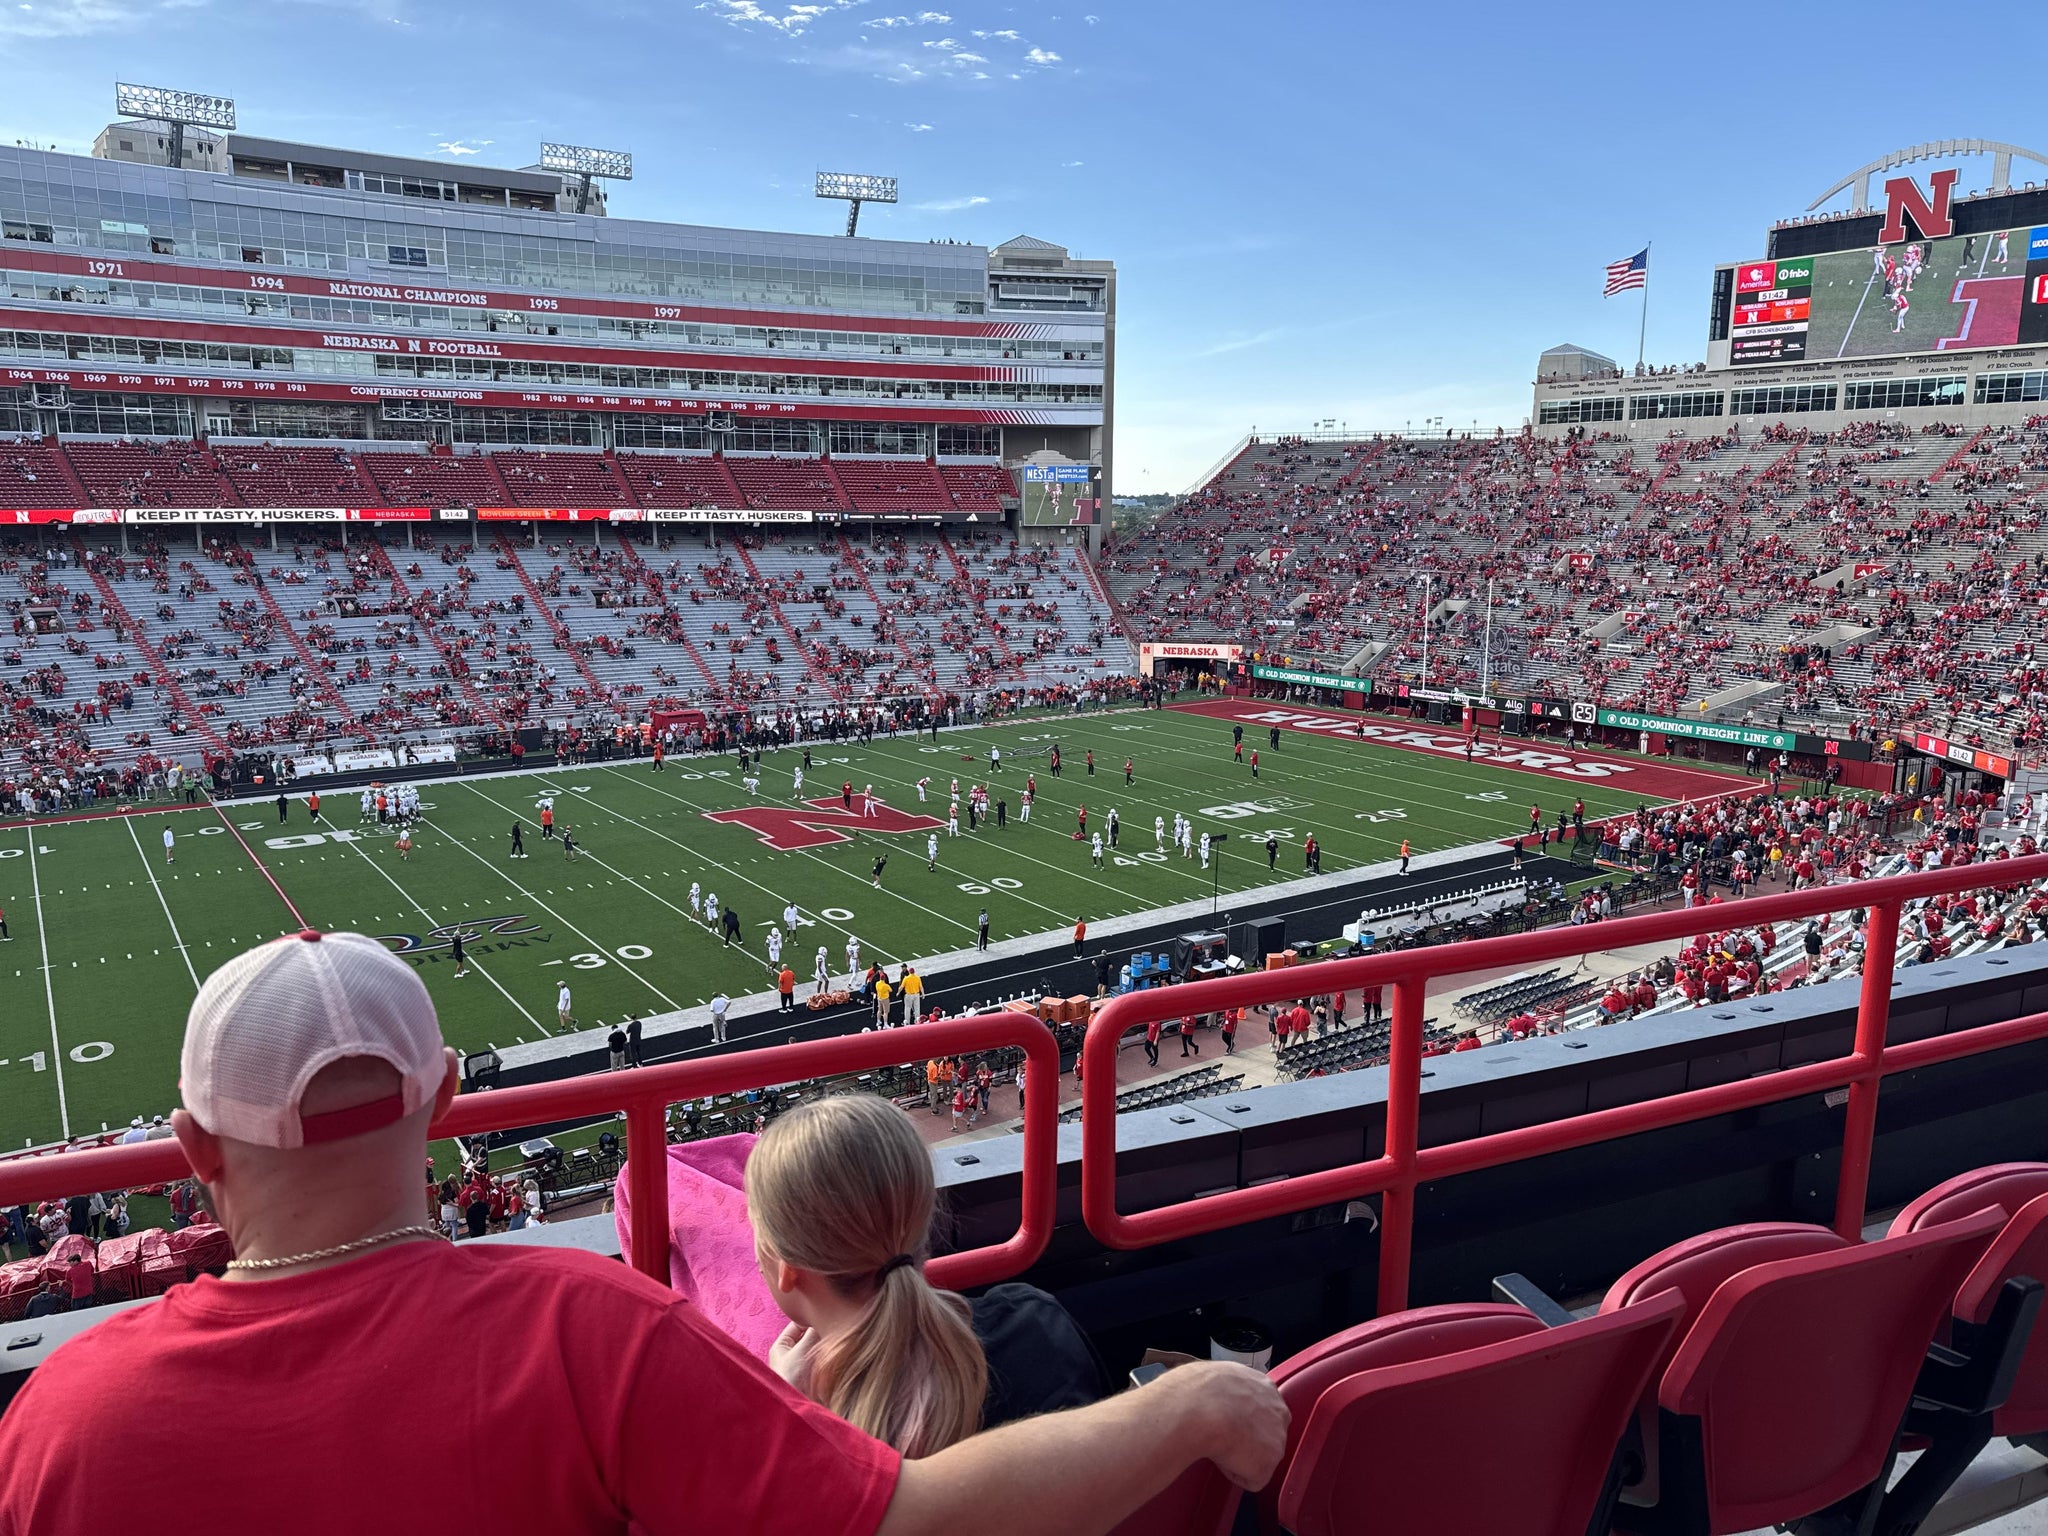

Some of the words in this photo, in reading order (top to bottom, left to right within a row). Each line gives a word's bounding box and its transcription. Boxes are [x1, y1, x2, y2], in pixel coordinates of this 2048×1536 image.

[1878, 168, 1961, 245] N
[1775, 206, 1878, 230] MEMORIAL
[88, 261, 124, 276] 1971
[1790, 269, 1809, 278] fnbo
[250, 276, 284, 290] 1994
[1740, 280, 1771, 290] Ameritas
[329, 283, 401, 299] NATIONAL
[404, 289, 487, 305] CHAMPIONS
[1762, 291, 1785, 300] 51:42
[529, 298, 558, 310] 1995
[654, 307, 681, 319] 1997
[1747, 311, 1758, 323] N
[1757, 325, 1795, 334] SCOREBOARD
[323, 335, 399, 350] NEBRASKA
[408, 340, 421, 352] N
[428, 341, 501, 356] FOOTBALL
[8, 370, 33, 380] 1964
[45, 371, 70, 381] 1966
[83, 373, 107, 384] 1969
[118, 375, 142, 385] 1970
[154, 377, 176, 387] 1971
[187, 379, 210, 389] 1972
[221, 380, 244, 390] 1975
[254, 382, 276, 391] 1978
[286, 383, 307, 393] 1981
[350, 386, 419, 398] CONFERENCE
[420, 389, 483, 400] CHAMPIONS
[522, 394, 540, 402] 1982
[549, 395, 567, 403] 1983
[576, 396, 594, 404] 1984
[602, 397, 620, 405] 1988
[629, 398, 645, 406] 1991
[730, 402, 747, 410] 1995
[779, 404, 796, 412] 1999
[1027, 468, 1049, 479] NEST
[16, 511, 30, 523] N
[136, 511, 175, 521] KEEP
[185, 511, 199, 520] IT
[202, 510, 258, 522] TASTY,
[261, 510, 339, 520] HUSKERS.
[349, 510, 361, 520] N
[568, 510, 579, 520] N
[655, 511, 687, 519] KEEP
[689, 511, 702, 519] IT
[704, 512, 746, 521] TASTY,
[747, 512, 807, 520] HUSKERS.
[1143, 646, 1150, 654] N
[1162, 646, 1218, 656] NEBRASKA
[1232, 648, 1239, 656] N
[1238, 664, 1245, 674] N
[1472, 660, 1520, 675] Alstate
[1266, 670, 1279, 678] OLD
[1279, 672, 1310, 683] DOMINION
[1311, 675, 1339, 687] FREIGHT
[1340, 679, 1356, 689] LINE
[1398, 685, 1409, 697] N
[1532, 703, 1542, 715] N
[1576, 706, 1592, 716] 25
[1619, 716, 1639, 726] OLD
[1641, 718, 1692, 734] DOMINION
[1695, 726, 1741, 741] FREIGHT
[1744, 732, 1769, 744] LINE
[1233, 710, 1637, 778] HUSKERS
[1824, 740, 1839, 755] N
[1927, 738, 1936, 752] N
[1951, 749, 1970, 762] 51:42
[1355, 807, 1408, 823] 20
[701, 793, 951, 851] N
[1239, 829, 1295, 844] 30
[1113, 850, 1169, 867] 40
[957, 877, 1023, 895] 50
[796, 907, 855, 928] 40
[568, 944, 653, 970] 30
[18, 1040, 115, 1073] 10
